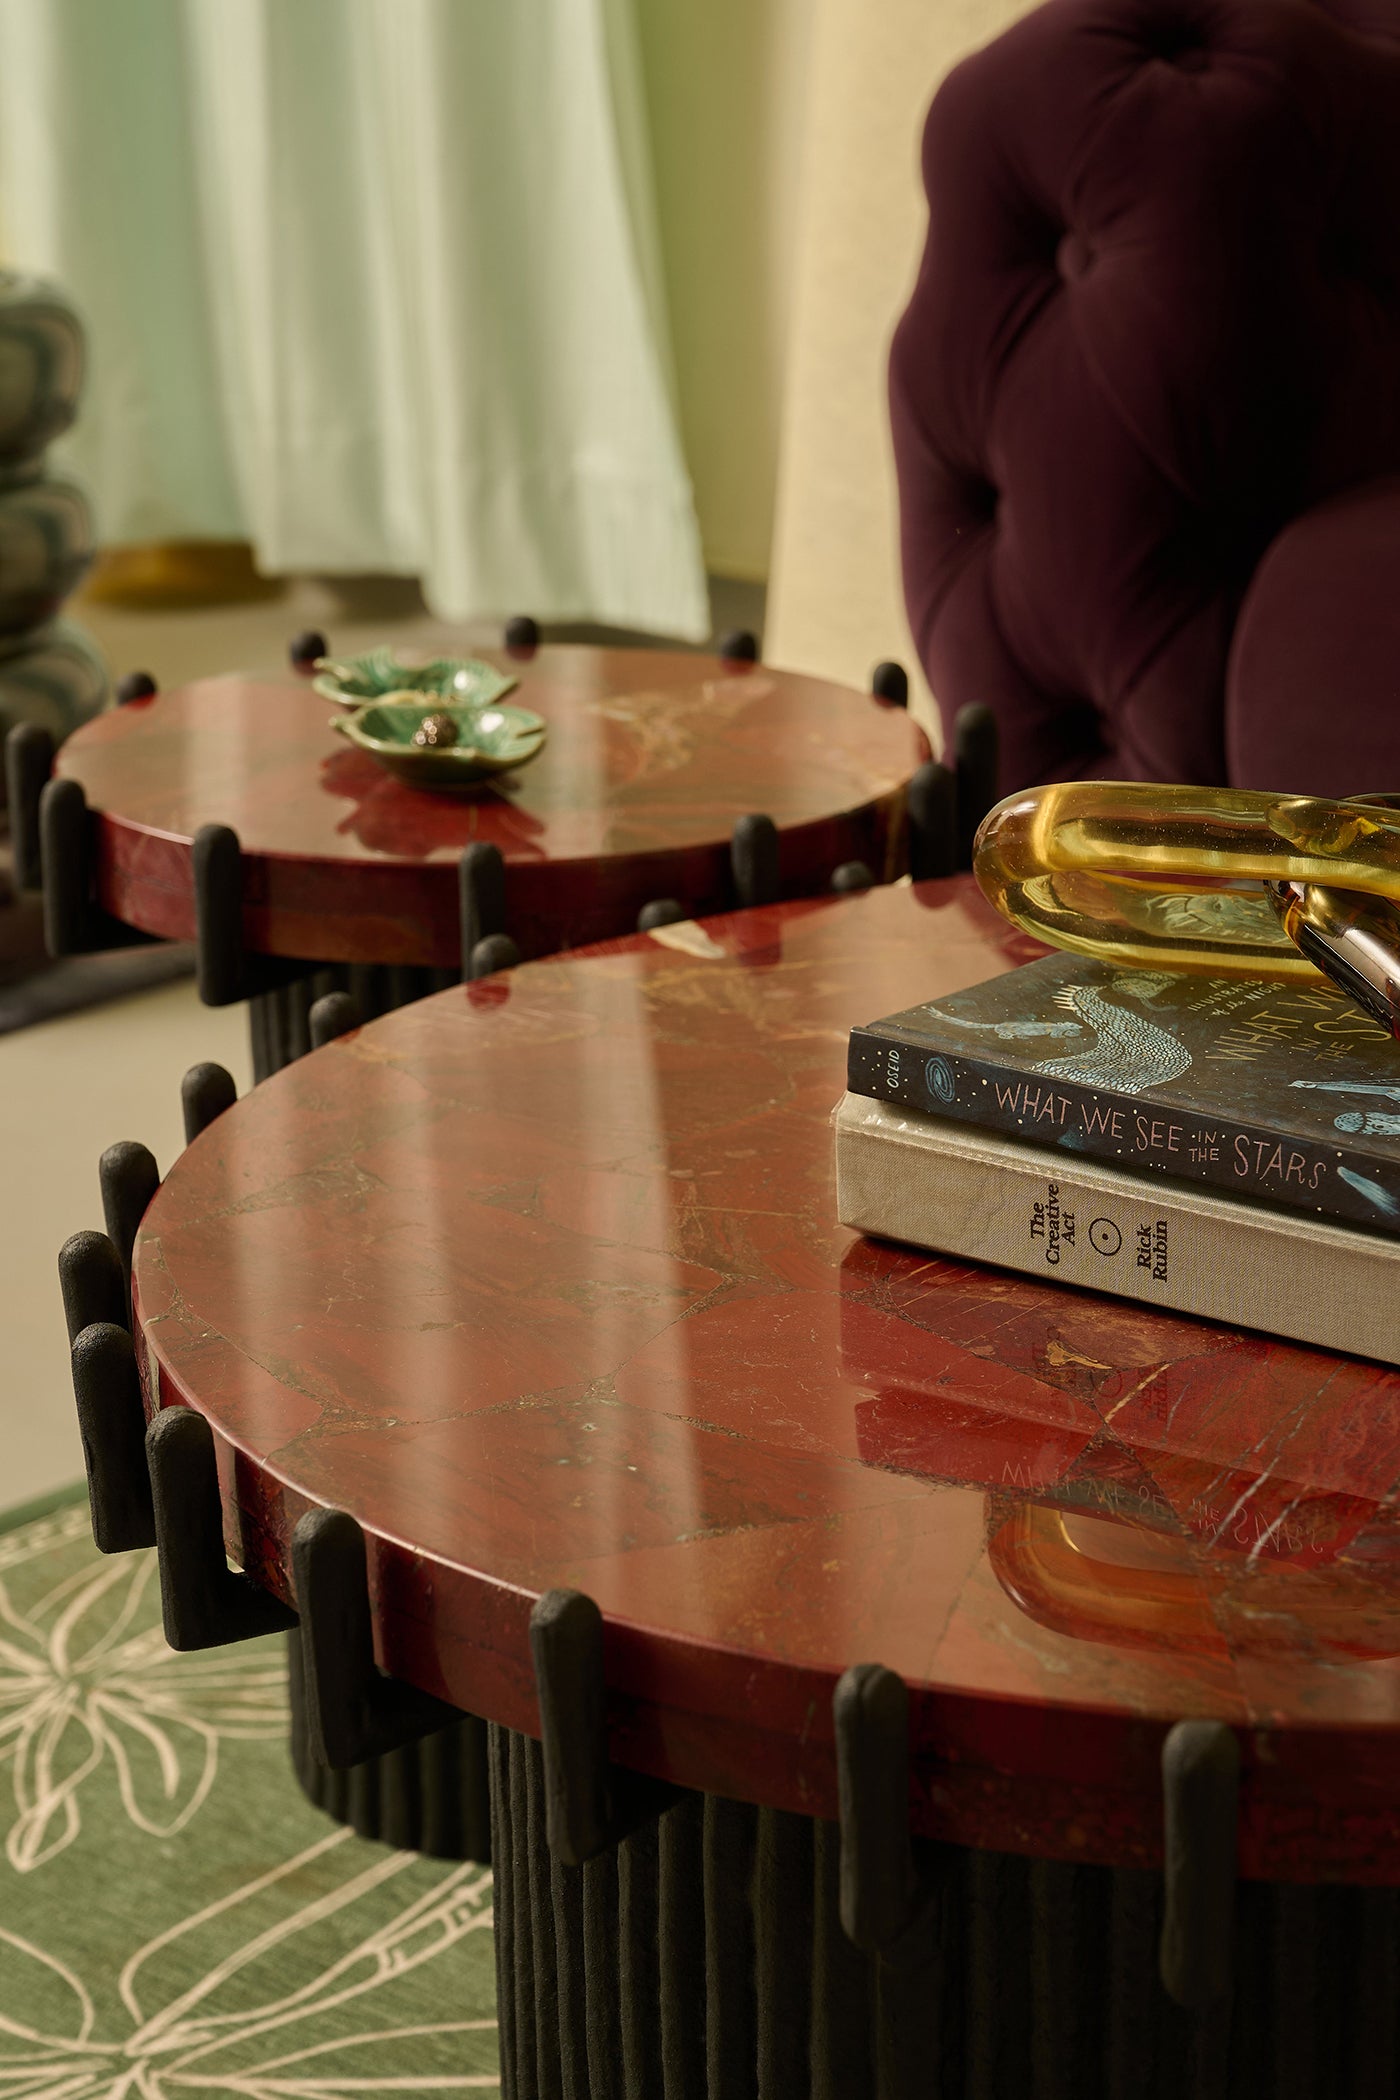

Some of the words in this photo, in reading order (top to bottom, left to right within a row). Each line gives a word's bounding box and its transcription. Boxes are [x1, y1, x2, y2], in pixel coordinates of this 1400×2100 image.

[1244, 982, 1287, 1001] NIGHT
[1202, 1010, 1303, 1061] WHAT
[1291, 1037, 1321, 1053] IN
[1314, 1041, 1355, 1063] THE
[886, 1049, 900, 1089] OSEID
[995, 1082, 1073, 1125] WHAT
[1081, 1103, 1126, 1139] WE
[1135, 1115, 1184, 1152] SEE
[1197, 1130, 1218, 1144] IN
[1188, 1148, 1220, 1163] THE
[1233, 1134, 1327, 1189] STARS
[1030, 1202, 1045, 1239] The
[1046, 1184, 1060, 1265] Creative
[1061, 1211, 1076, 1247] Act
[1136, 1223, 1152, 1270] Rick
[1152, 1220, 1168, 1283] Rubin
